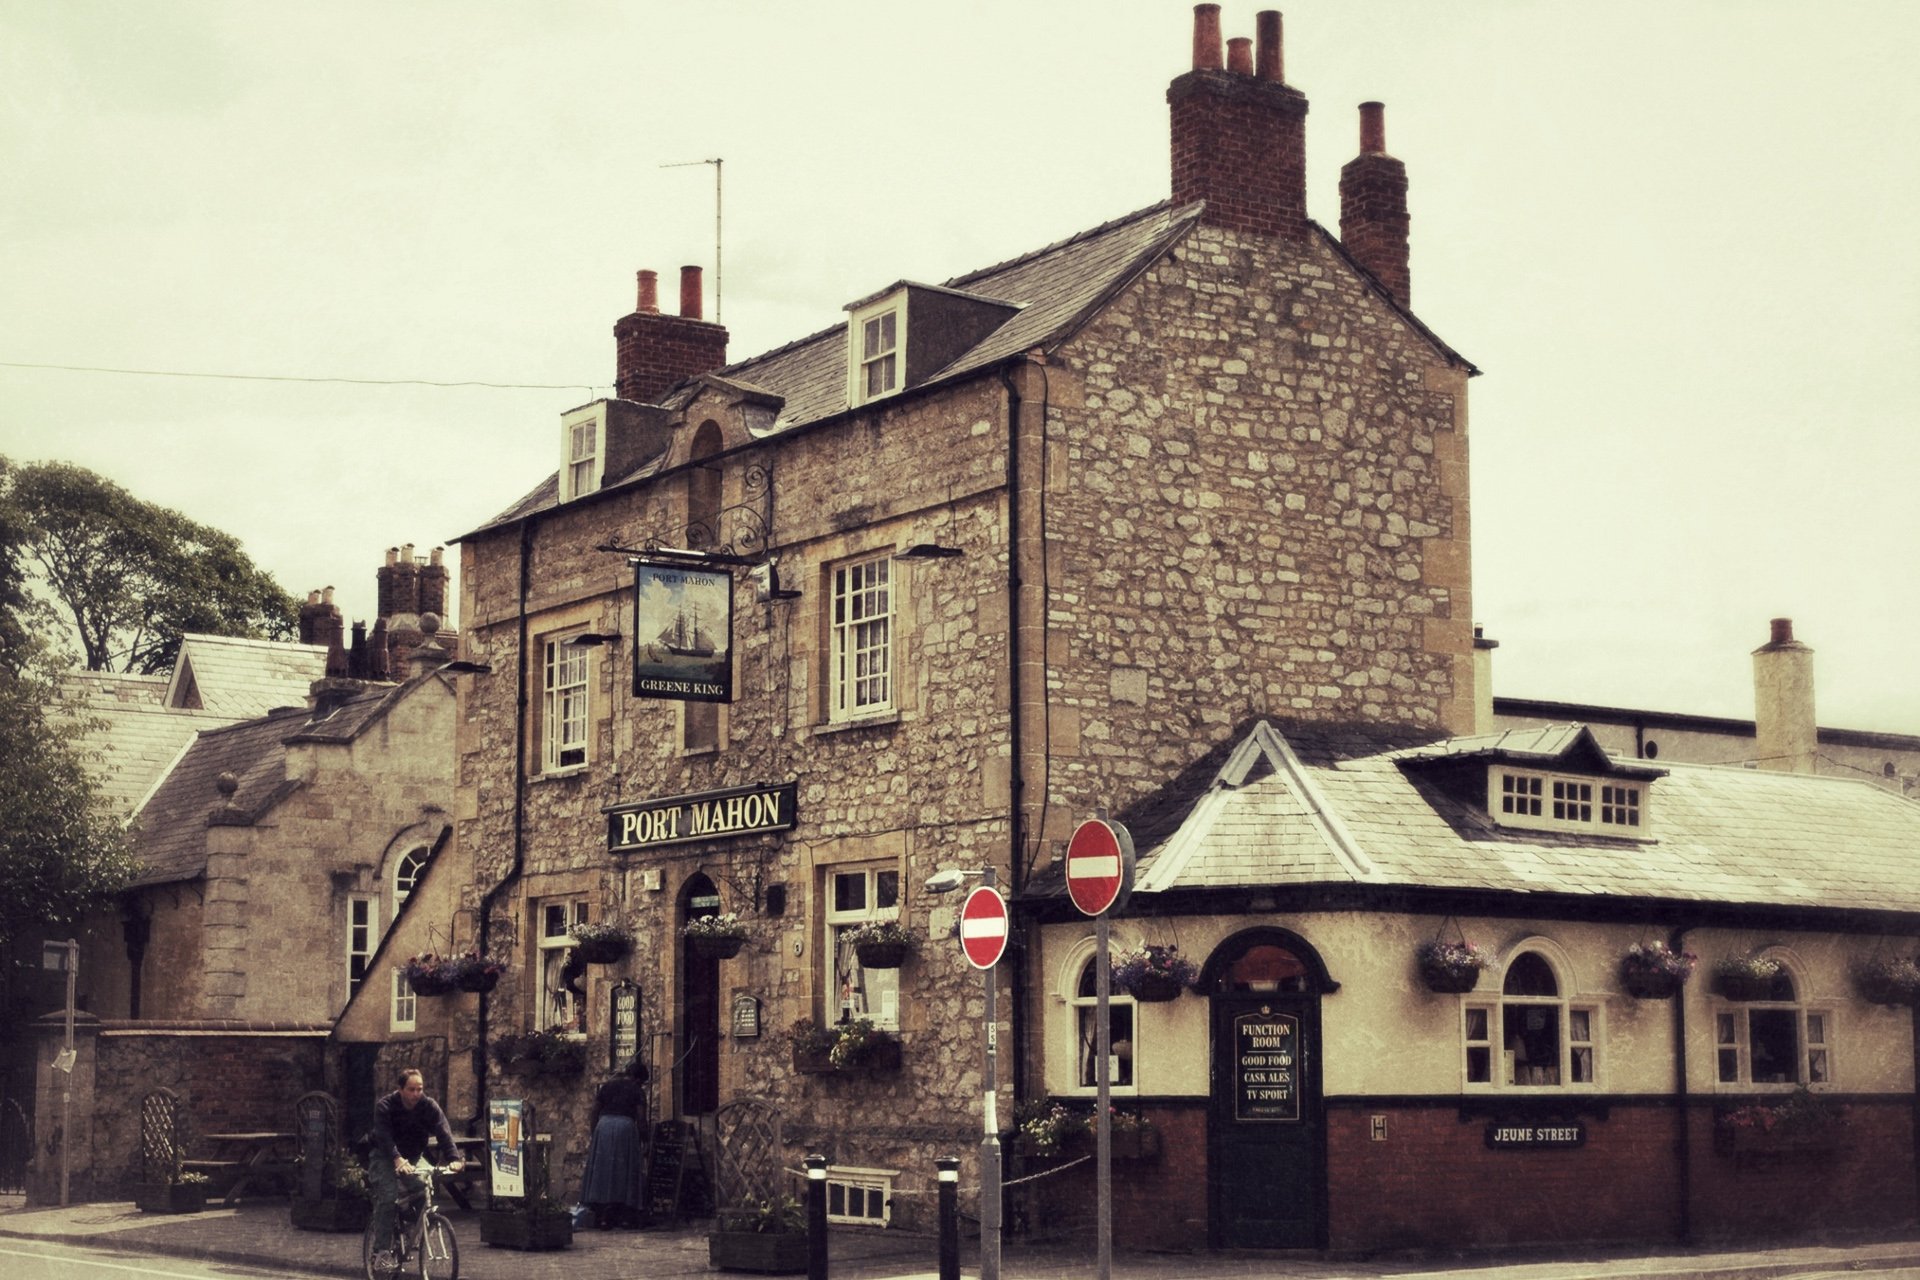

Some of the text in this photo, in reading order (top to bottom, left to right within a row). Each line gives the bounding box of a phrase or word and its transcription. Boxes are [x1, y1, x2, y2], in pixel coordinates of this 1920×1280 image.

[652, 573, 716, 587] PORT MAHON
[641, 679, 724, 696] GREENE KING
[621, 791, 781, 845] PORT MAHON
[617, 995, 635, 1010] GOOD
[617, 1011, 635, 1025] FOOD
[1242, 1024, 1290, 1036] FUNCTION
[1252, 1036, 1281, 1048] ROOM
[1241, 1055, 1292, 1066] GOOD FOOD
[1244, 1072, 1290, 1083] CASK ALES
[1247, 1090, 1288, 1100] TV SPORT
[1494, 1128, 1579, 1142] JEUNE STREET
